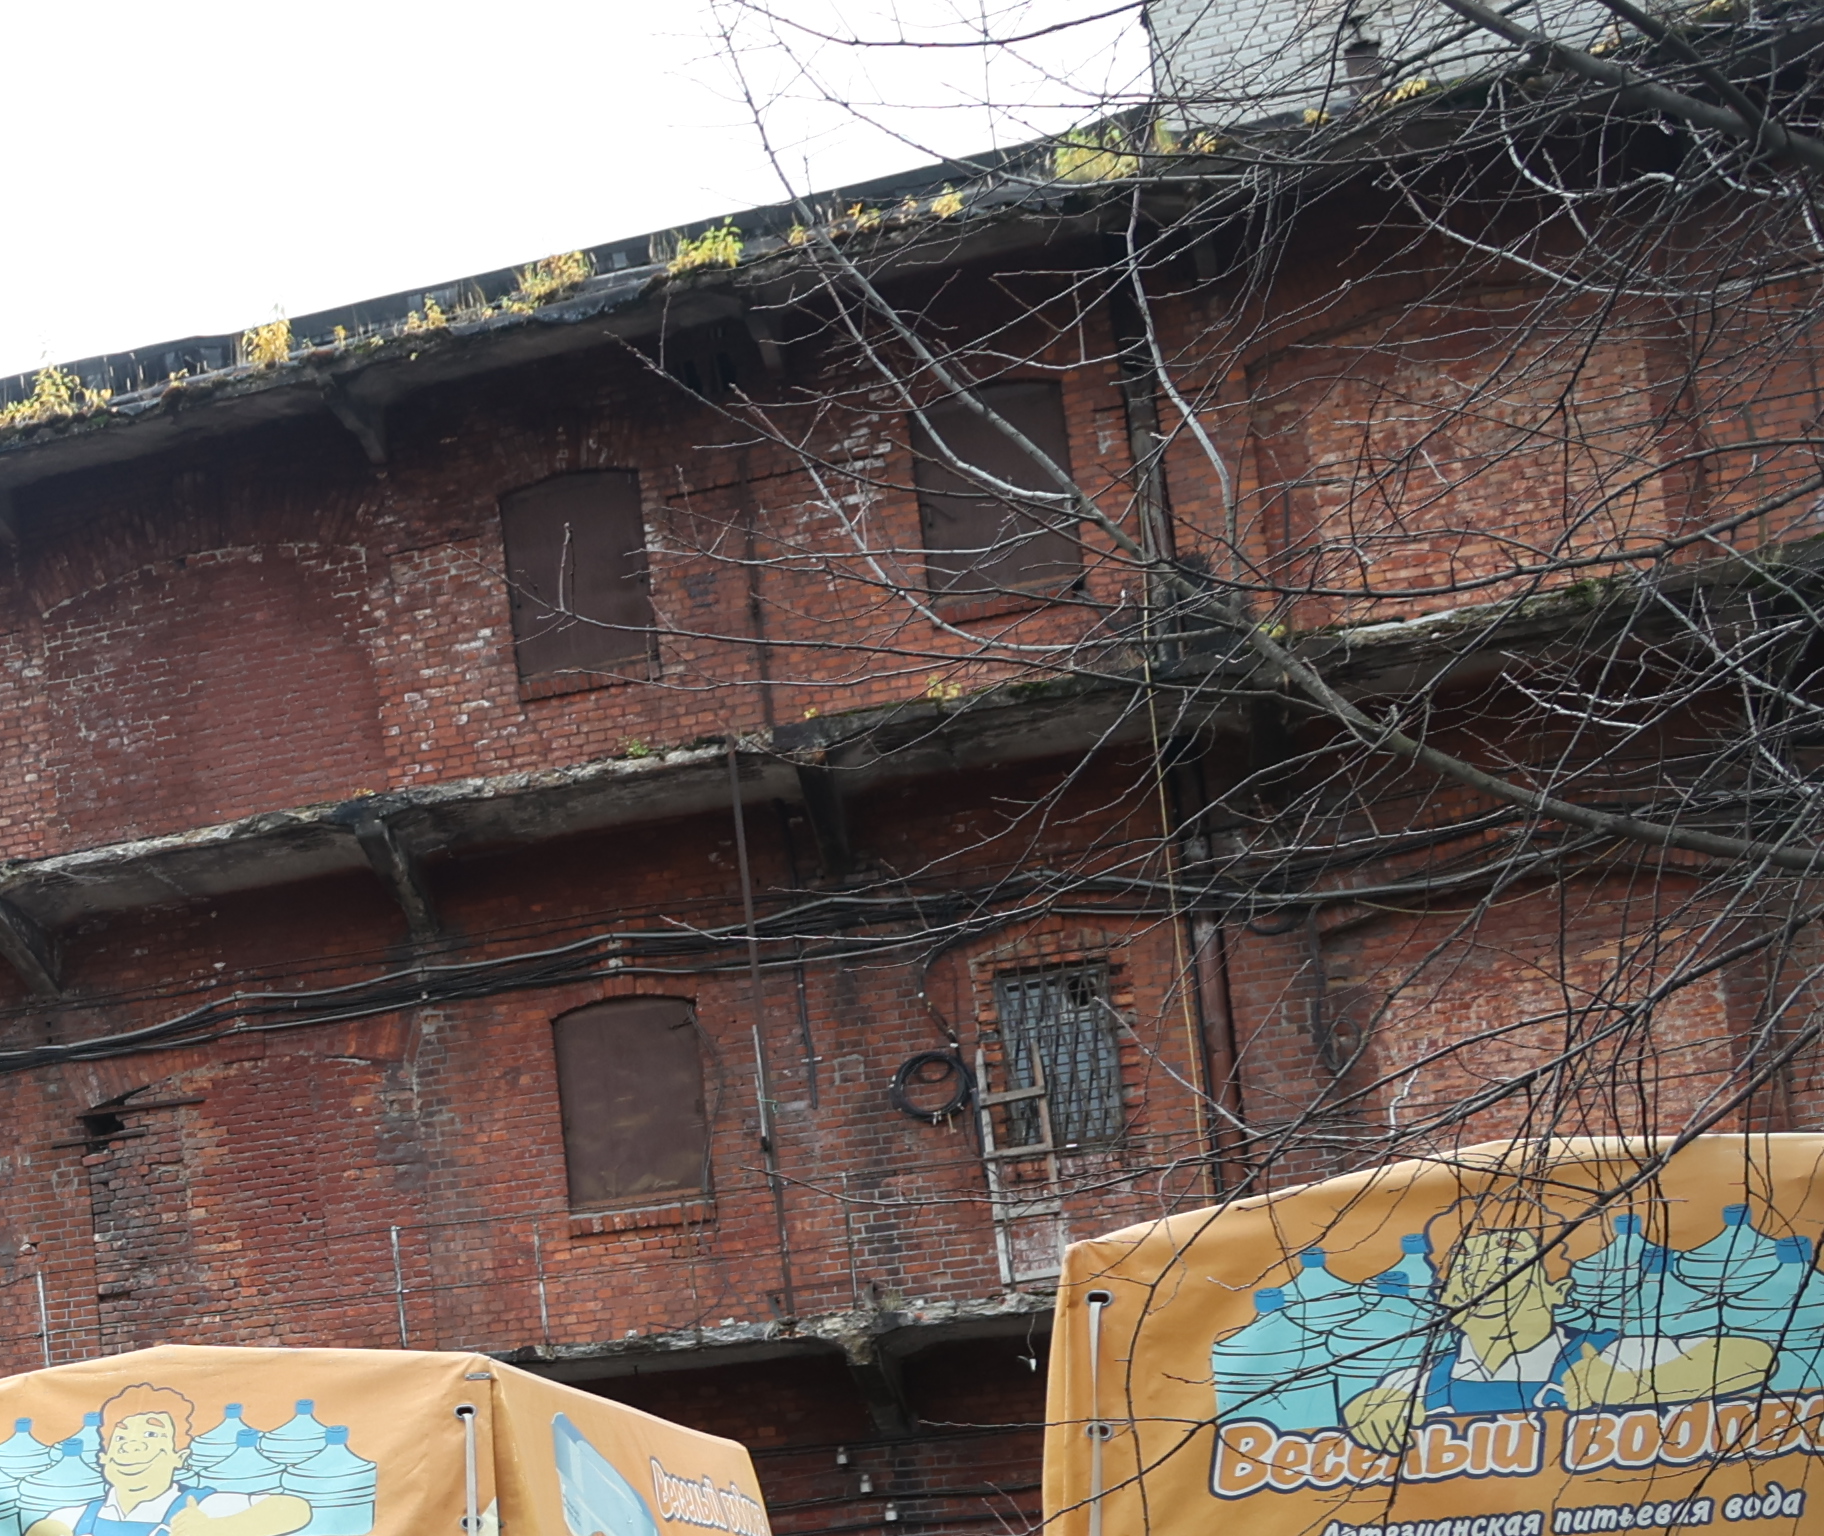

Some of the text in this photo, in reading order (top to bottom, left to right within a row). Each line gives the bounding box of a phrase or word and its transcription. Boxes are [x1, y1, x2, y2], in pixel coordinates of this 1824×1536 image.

[1209, 1414, 1545, 1500] Веселый
[1551, 1496, 1714, 1536] питьевая
[1721, 1481, 1806, 1521] вода
